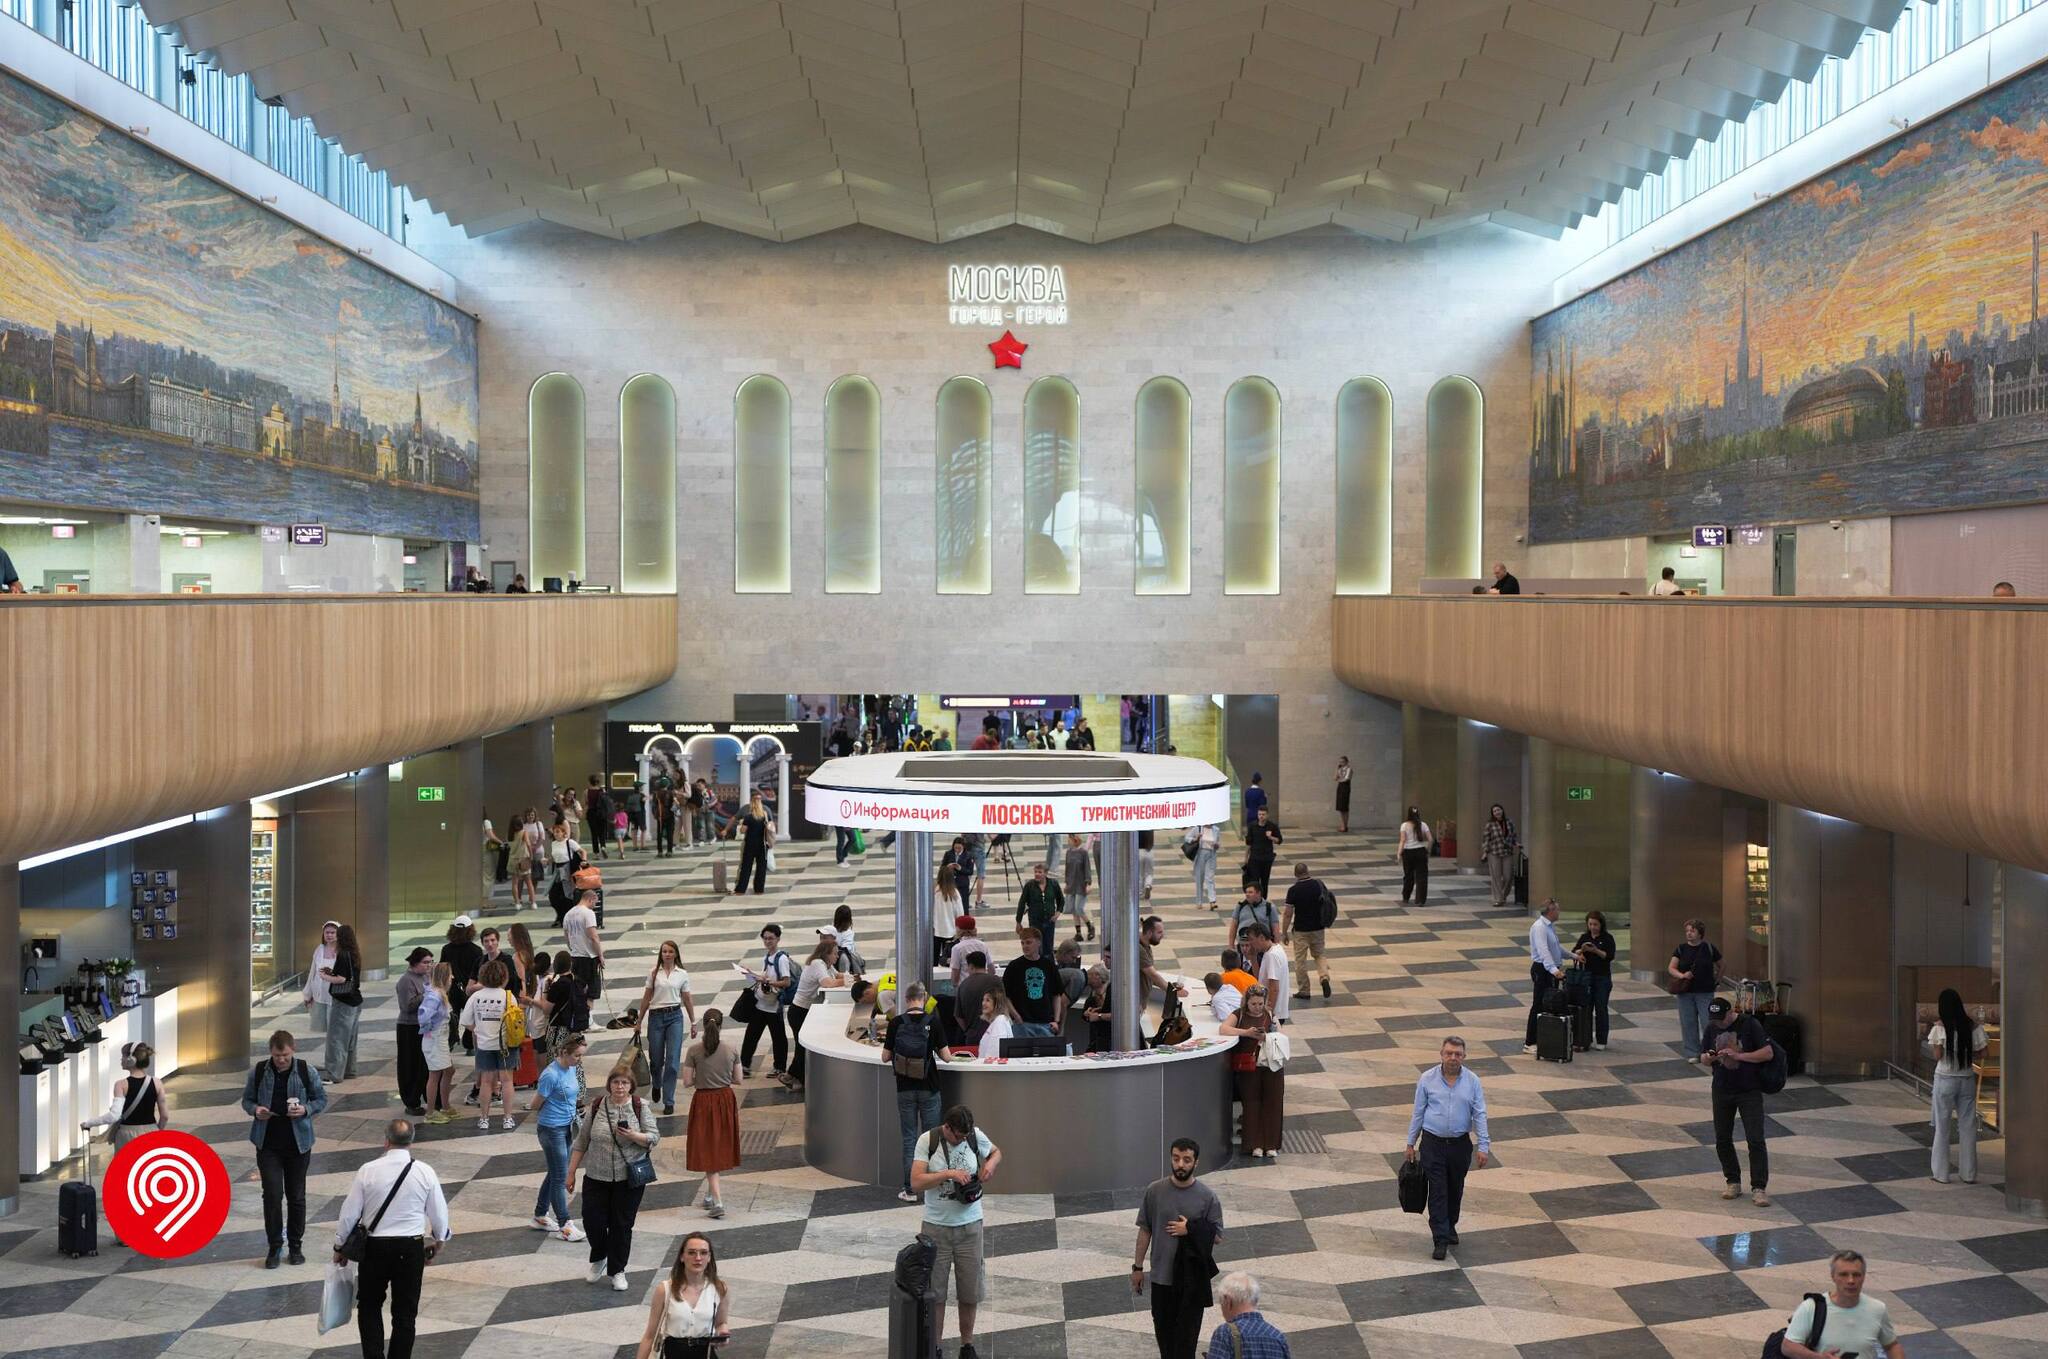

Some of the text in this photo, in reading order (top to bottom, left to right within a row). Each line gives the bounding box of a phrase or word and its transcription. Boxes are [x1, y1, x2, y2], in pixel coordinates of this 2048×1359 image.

[950, 265, 1067, 303] МОСКВА
[950, 305, 1003, 326] ГОРОД
[1016, 303, 1067, 325] ГЕРОЙ
[853, 801, 950, 822] Информация
[981, 804, 1055, 826] МОСКВА
[1080, 801, 1197, 822] ТУРИСТИЧЕСКИЙ ЦЕНТР
